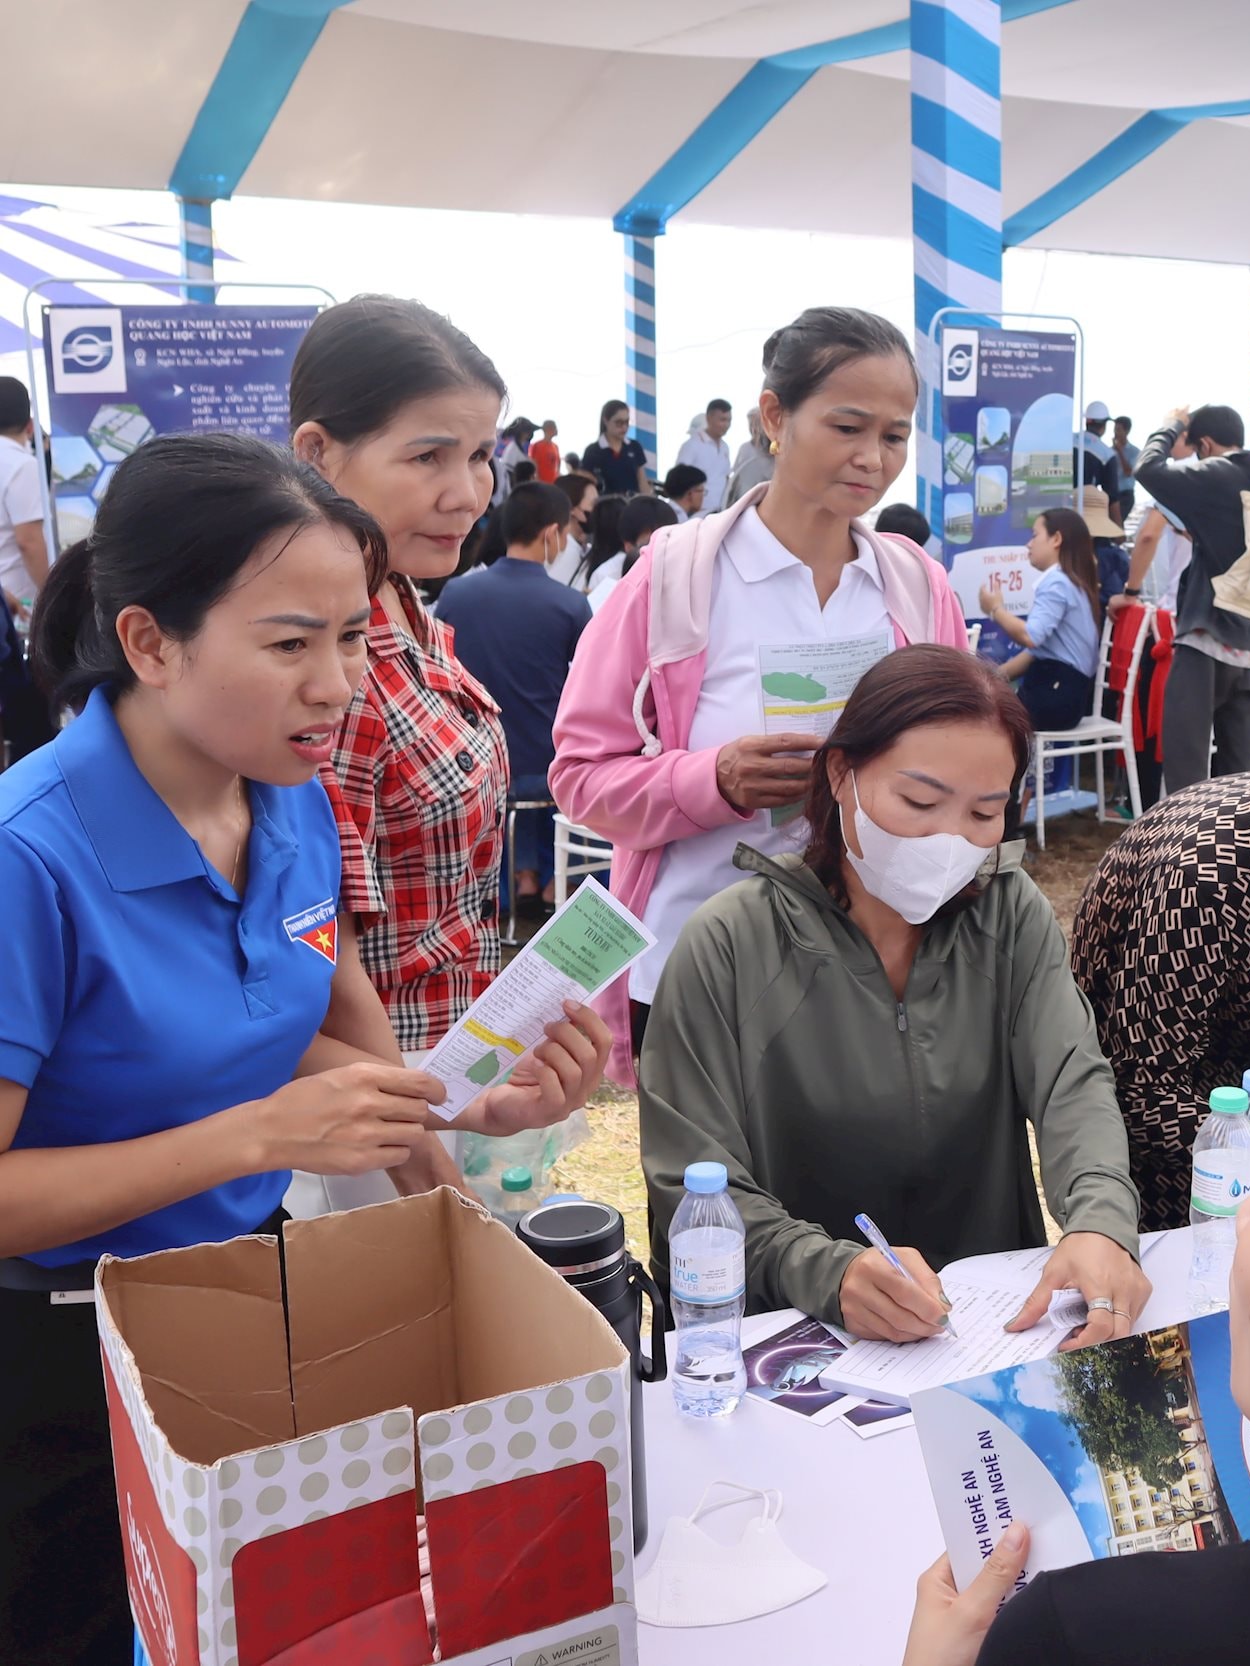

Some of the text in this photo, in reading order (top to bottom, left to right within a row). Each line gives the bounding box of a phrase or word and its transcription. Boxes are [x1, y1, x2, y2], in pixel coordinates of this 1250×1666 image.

[128, 318, 161, 329] CÔNG
[165, 320, 178, 329] TY
[182, 320, 214, 329] TNHH
[255, 320, 313, 329] AUTOMOTI
[129, 331, 170, 342] QUANG
[200, 329, 224, 342] VIỆT
[226, 332, 252, 341] NAM
[674, 1265, 698, 1283] true
[674, 1281, 698, 1292] WATER
[977, 1429, 994, 1449] AN
[961, 1470, 978, 1490] AN
[980, 1452, 1006, 1494] NGHỆ
[964, 1493, 990, 1536] NGHỆ
[552, 1636, 602, 1661] WARNING
